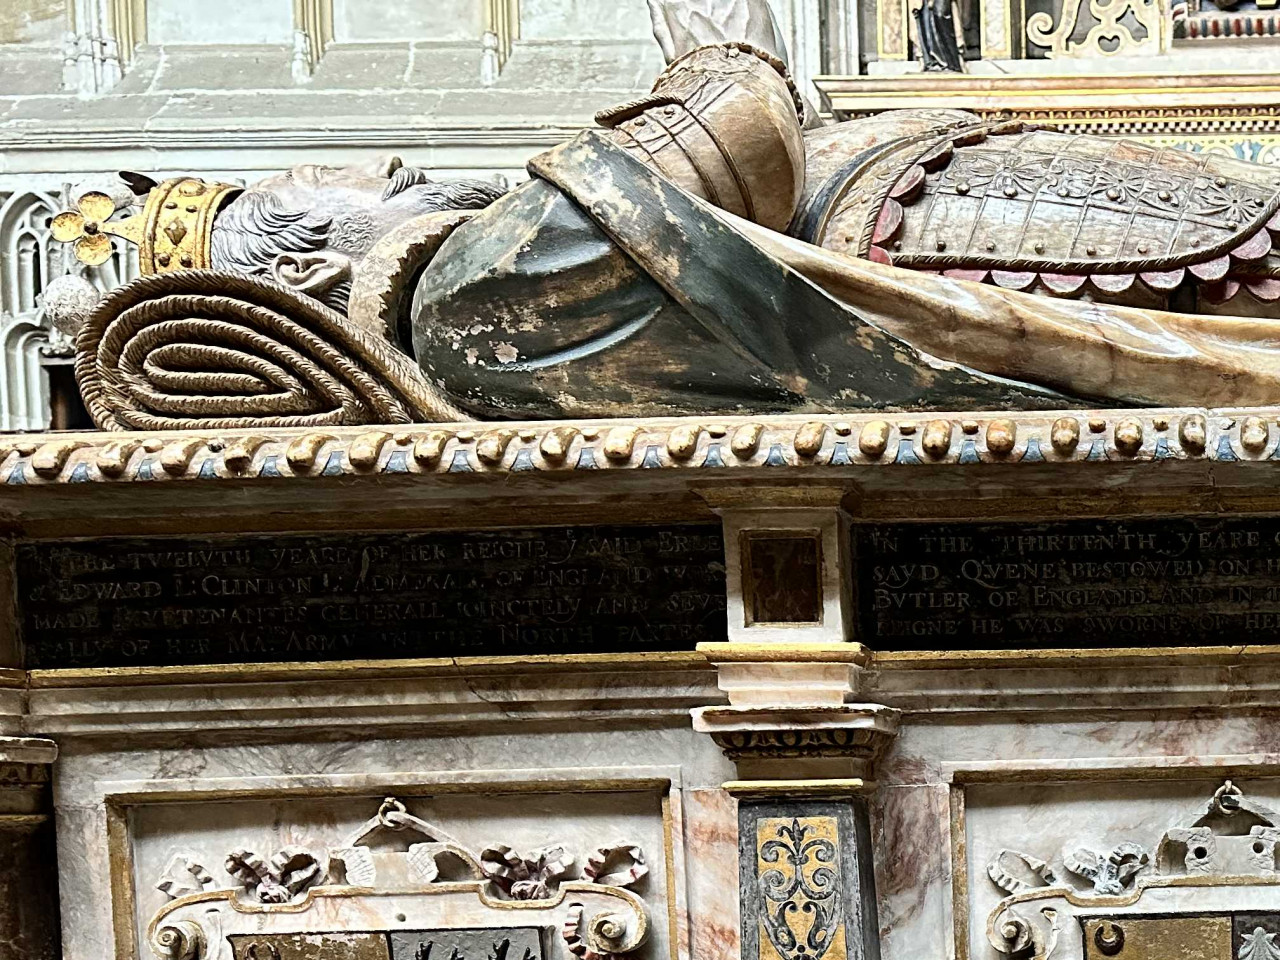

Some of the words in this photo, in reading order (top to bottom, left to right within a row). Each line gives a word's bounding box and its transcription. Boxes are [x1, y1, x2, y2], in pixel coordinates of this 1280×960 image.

[920, 536, 974, 554] THE
[1218, 557, 1251, 575] ON
[57, 578, 163, 602] EDWARD
[874, 588, 971, 610] BVTLER
[988, 590, 1019, 608] OF
[1228, 586, 1253, 602] IN
[970, 618, 1003, 635] HE
[1015, 615, 1066, 634] WAS
[1082, 613, 1182, 634] SWORNE
